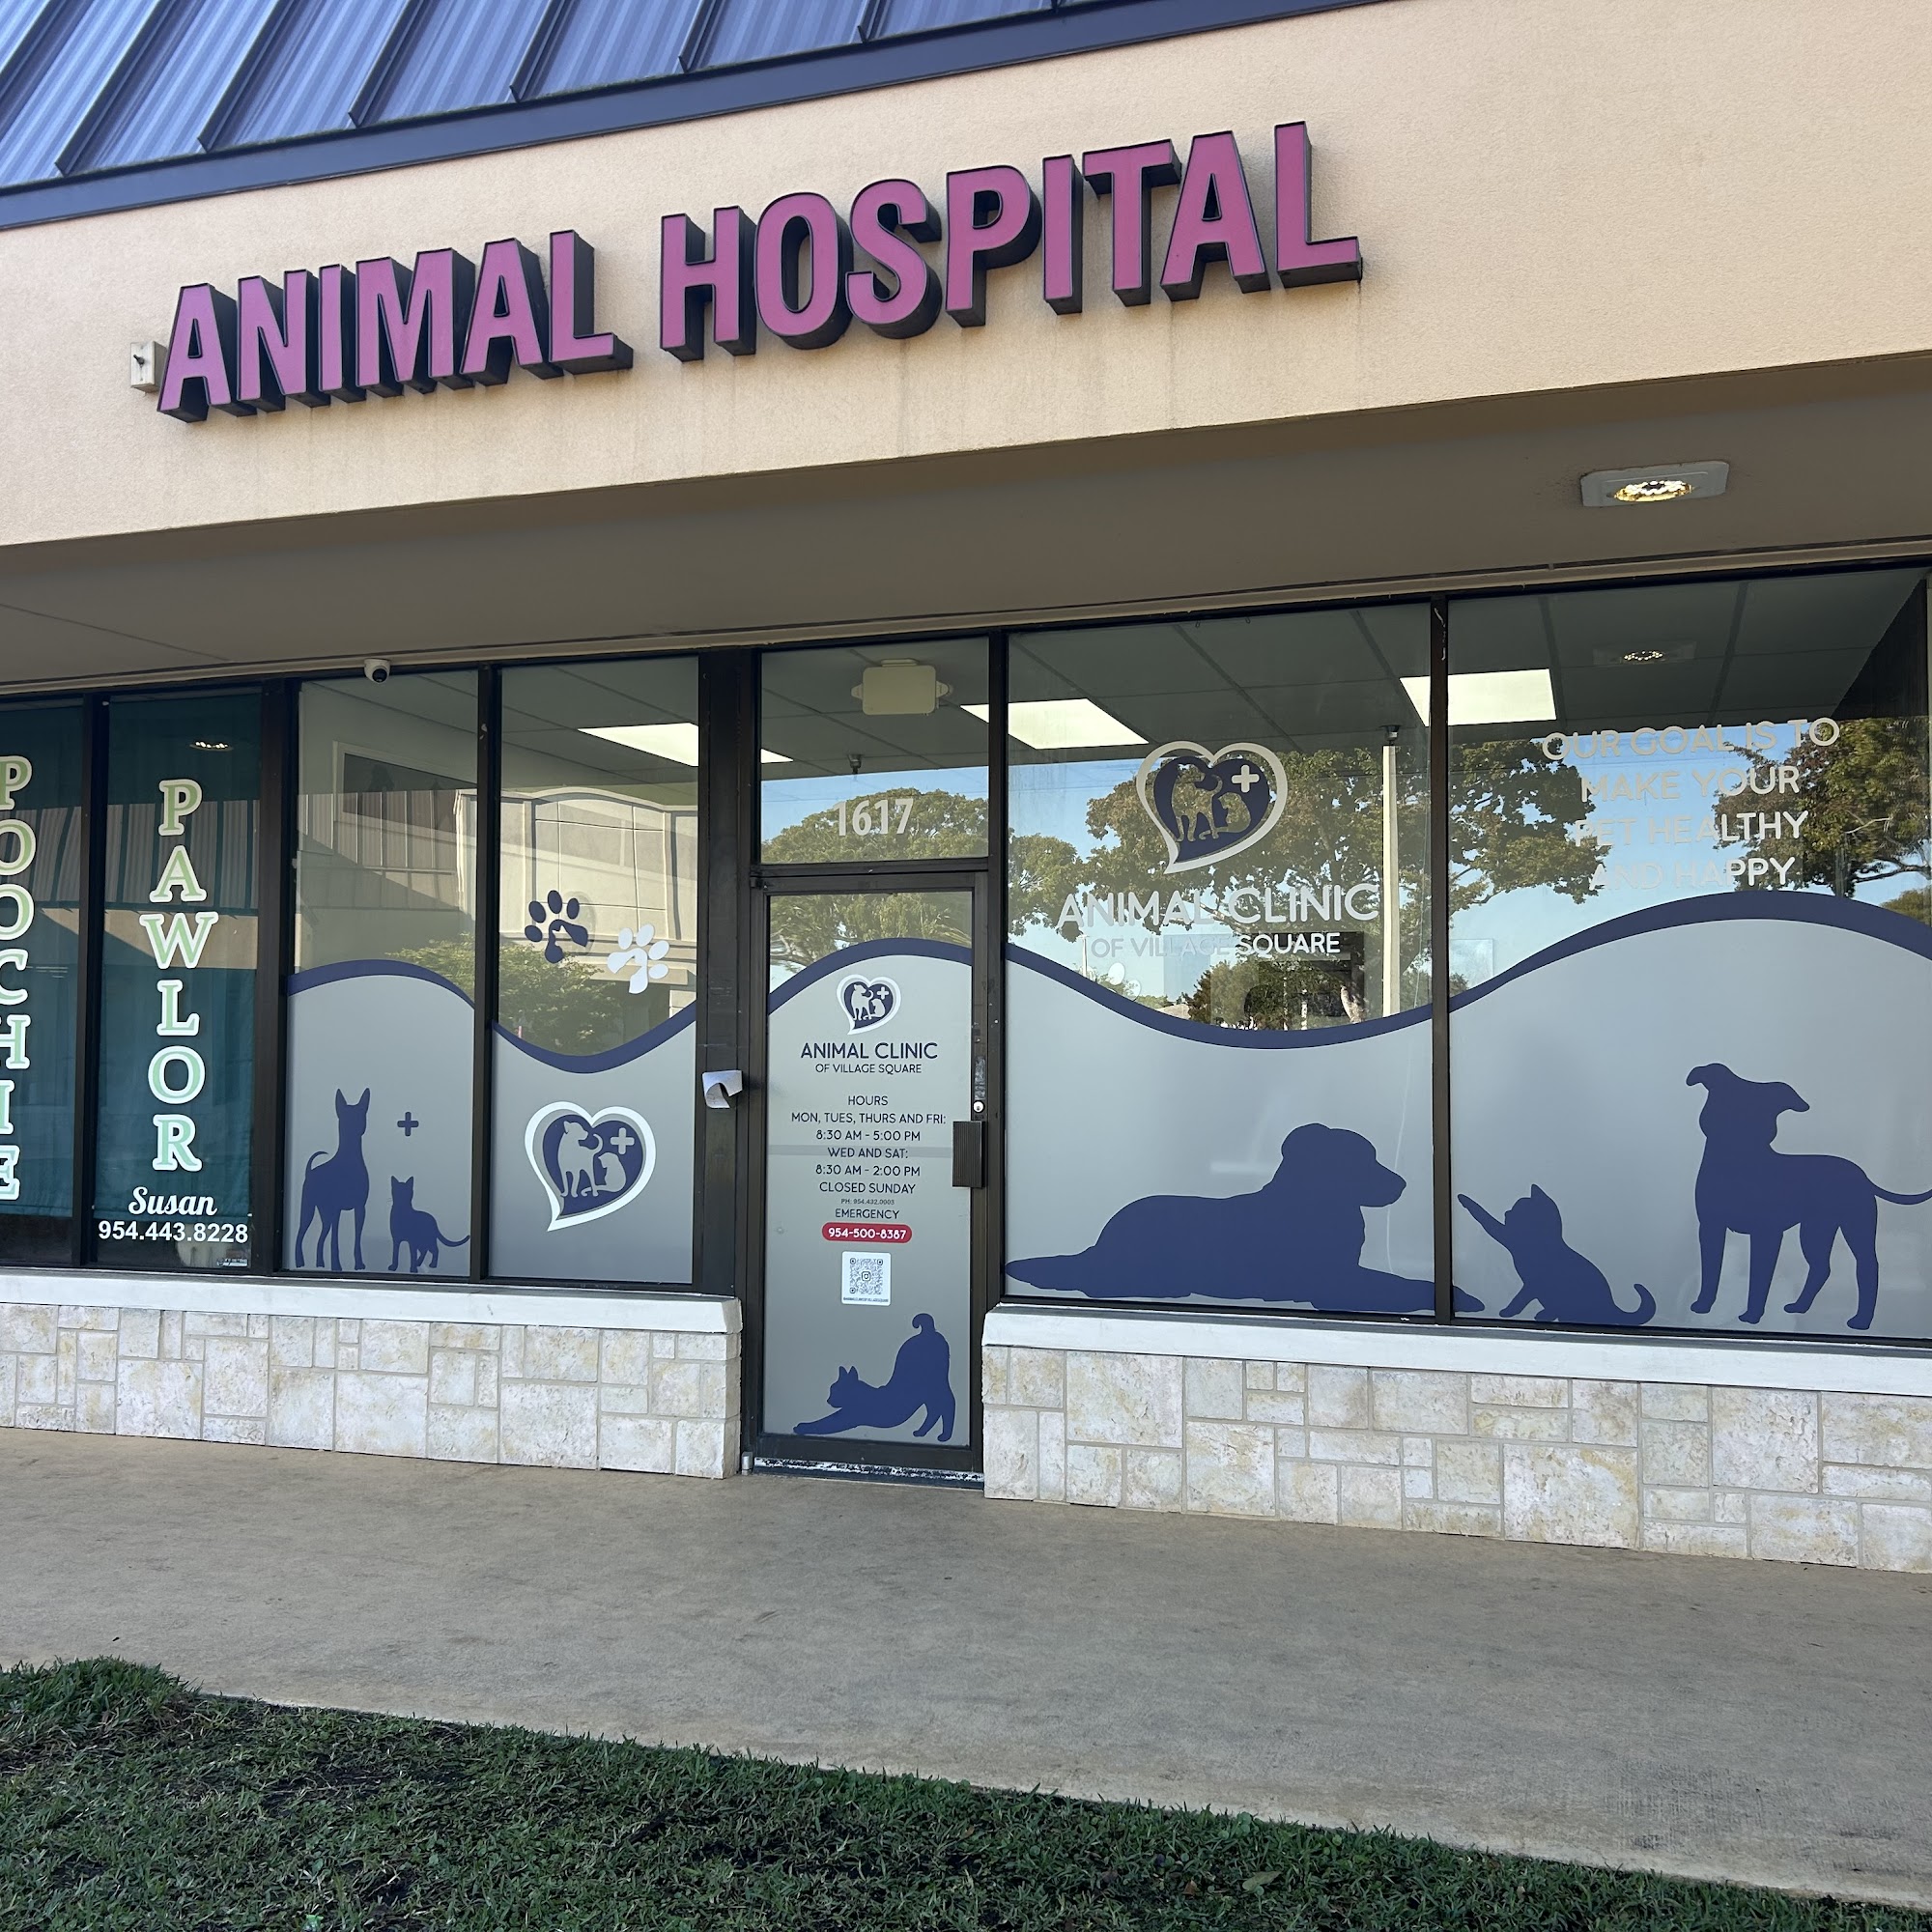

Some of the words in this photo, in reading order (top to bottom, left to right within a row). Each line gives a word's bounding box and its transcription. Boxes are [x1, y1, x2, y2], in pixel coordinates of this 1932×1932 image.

[156, 229, 618, 415] ANIMAL
[660, 122, 1360, 353] HOSPITAL
[1542, 730, 1620, 760] OUR
[1631, 724, 1734, 755] GOAL
[1746, 720, 1776, 751] IS
[1788, 717, 1840, 748] TO
[1580, 771, 1681, 802] MAKE
[1692, 765, 1800, 796] YOUR
[835, 798, 914, 837] 1617
[1575, 817, 1634, 846] PET
[1648, 810, 1809, 843] HEALTHY
[1674, 856, 1796, 888] HAPPY
[1058, 890, 1215, 929] ANIMAL
[1228, 883, 1380, 924] CLINIC
[1091, 937, 1124, 958] OF
[1131, 934, 1231, 957] VILLAGE
[1235, 932, 1341, 956] SQUARE
[139, 779, 219, 1172] PAWLOR
[800, 1042, 869, 1059] ANIMAL
[874, 1042, 938, 1059] CLINIC
[815, 1064, 830, 1073] OF
[833, 1064, 875, 1073] VILLAGE
[878, 1064, 922, 1074] SQUARE
[848, 1095, 889, 1105] HOURS
[791, 1112, 821, 1123] MON,
[824, 1113, 856, 1124] TUES,
[859, 1113, 895, 1123] THURS
[899, 1114, 923, 1123] AND
[925, 1114, 947, 1123] FRI:
[815, 1129, 841, 1140] 8:30
[844, 1130, 862, 1140] AM
[873, 1131, 900, 1141] 5:00
[904, 1131, 921, 1141] PM
[827, 1147, 855, 1157] WED
[858, 1148, 882, 1157] AND
[885, 1148, 908, 1158] SAT:
[815, 1164, 841, 1175] 8:30
[844, 1165, 862, 1175] AM
[872, 1166, 900, 1176] 2:00
[904, 1166, 921, 1176] PM
[819, 1181, 866, 1193] CLOSED
[868, 1182, 916, 1194] SUNDAY
[128, 1186, 217, 1216] Susan
[835, 1208, 899, 1219] EMERGENCY
[98, 1220, 248, 1243] 954.443.8228
[828, 1227, 906, 1239] 954-500-8387
